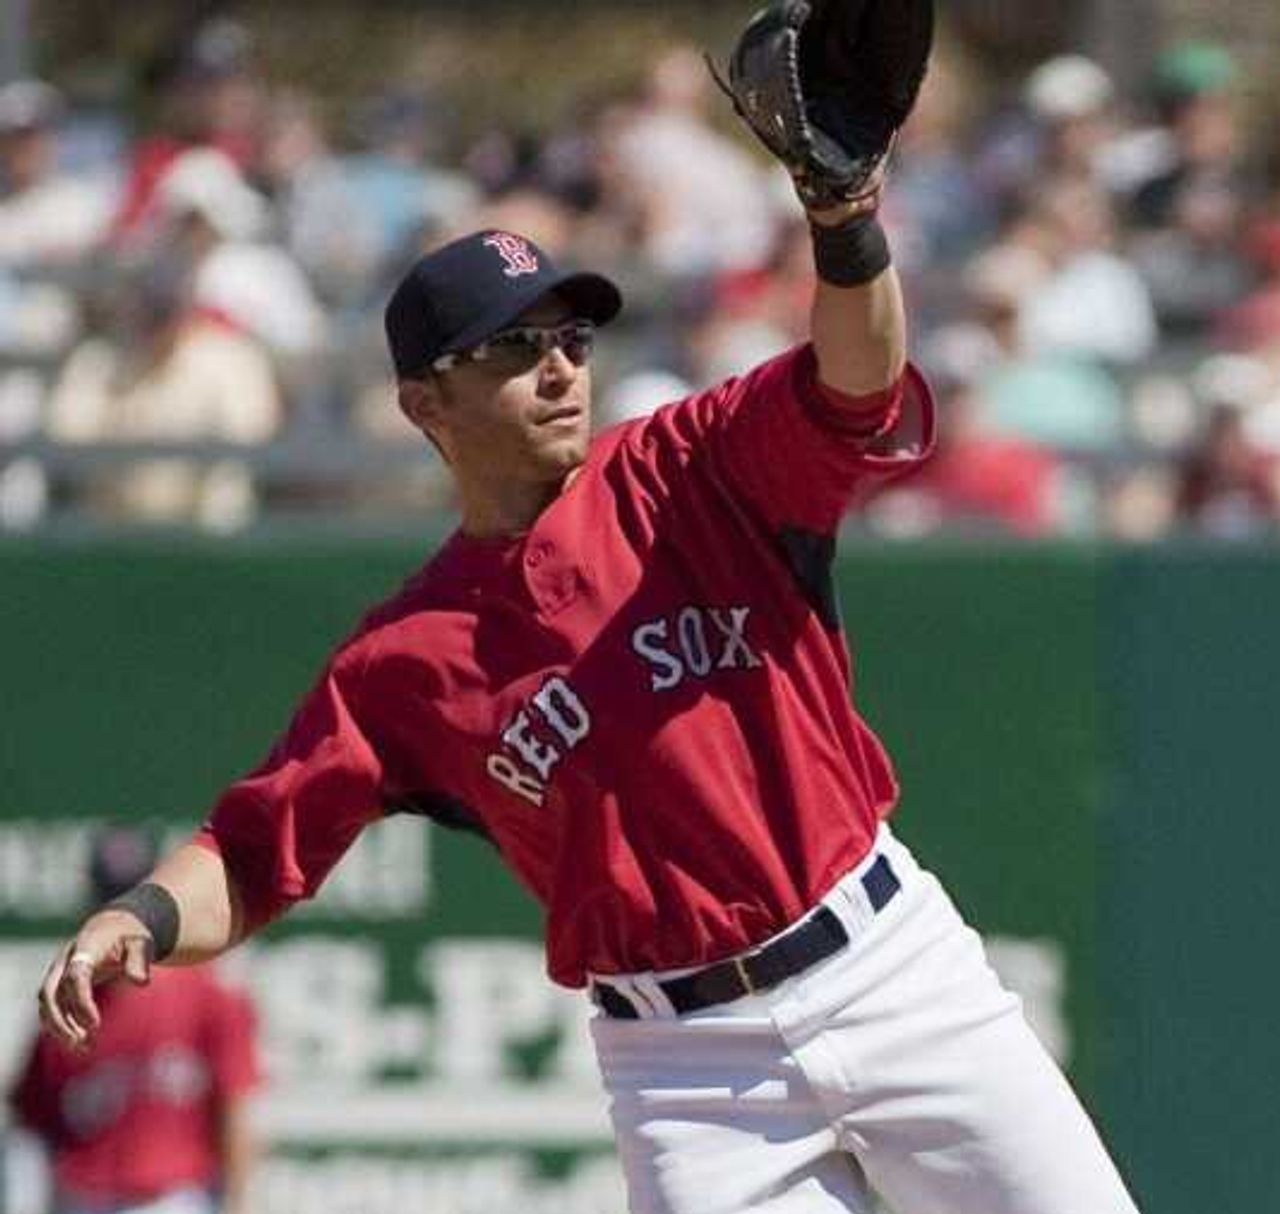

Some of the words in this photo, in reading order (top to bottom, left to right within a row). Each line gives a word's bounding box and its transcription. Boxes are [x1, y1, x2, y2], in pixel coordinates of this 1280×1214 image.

[483, 232, 539, 278] B
[486, 675, 592, 808] RED
[632, 605, 761, 692] SOX
